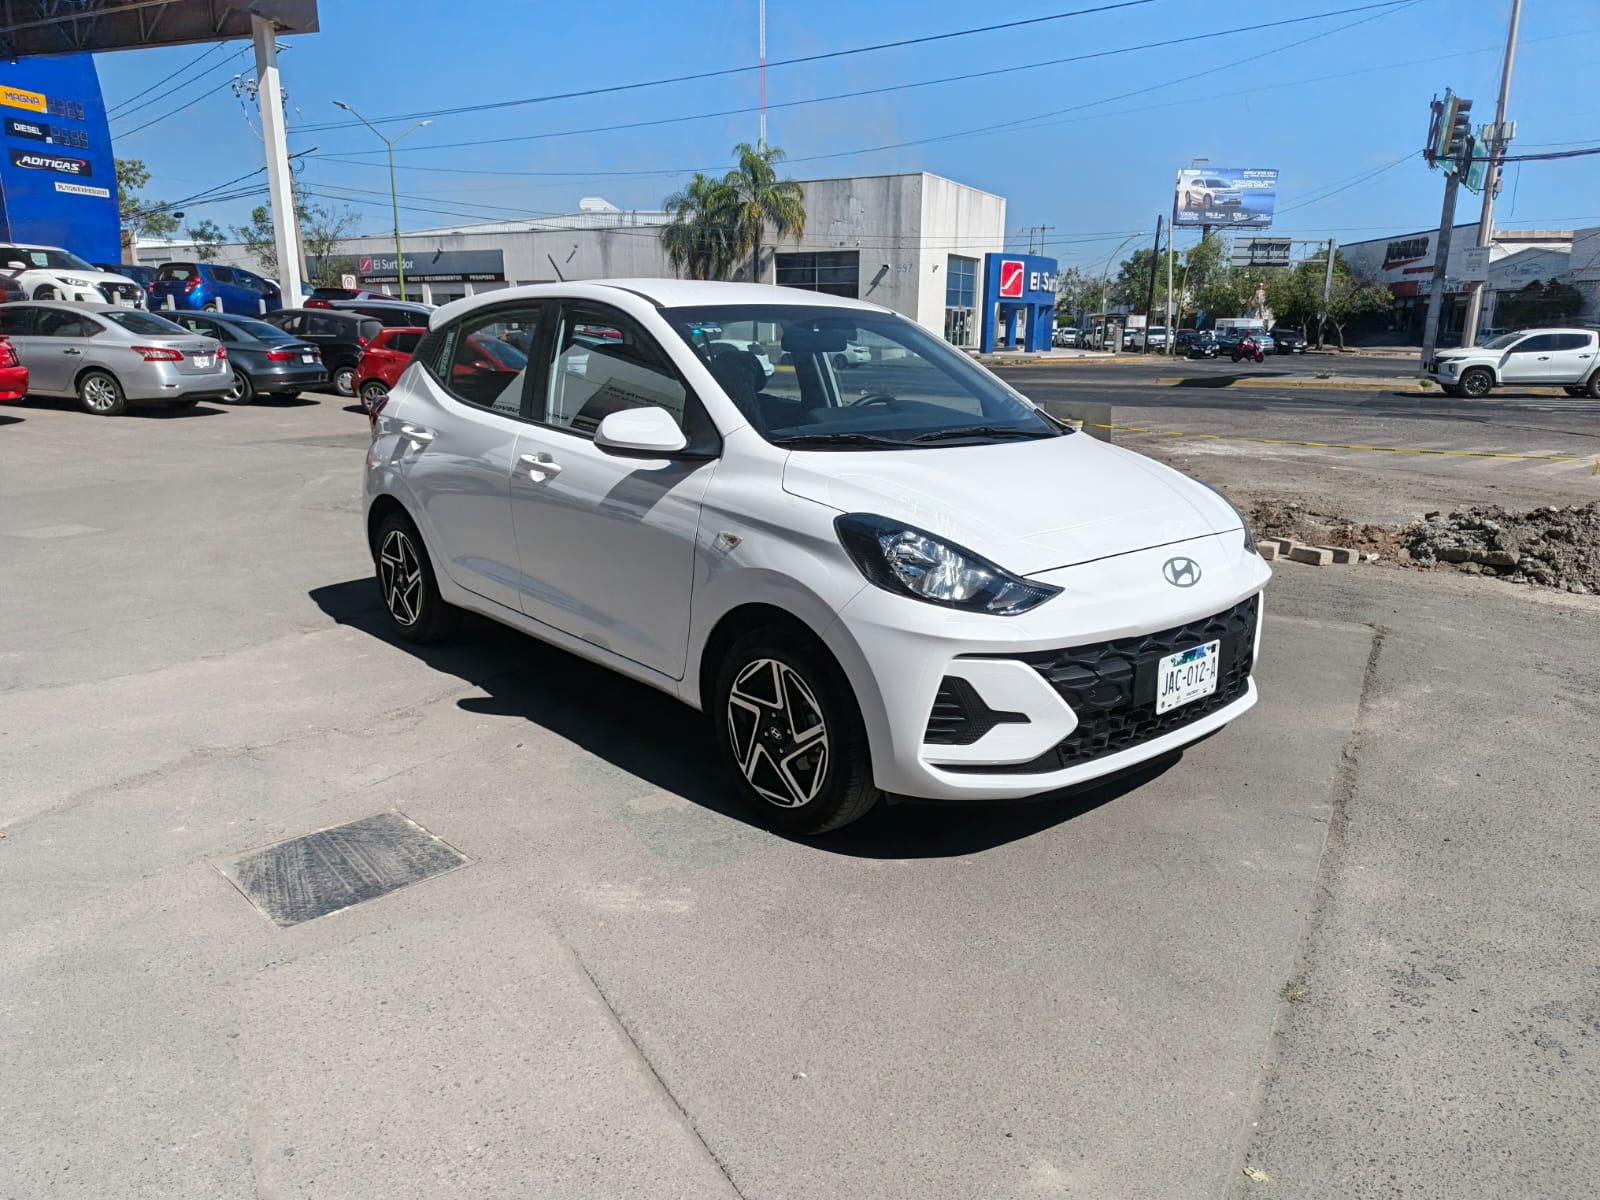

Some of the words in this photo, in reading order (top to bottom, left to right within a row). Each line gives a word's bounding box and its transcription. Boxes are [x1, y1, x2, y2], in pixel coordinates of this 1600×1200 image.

[4, 91, 41, 105] MAGNA
[13, 122, 42, 135] DIESEL
[22, 155, 80, 171] ADITIGAS
[373, 259, 380, 270] El
[381, 258, 414, 271] Surtdor
[1029, 271, 1041, 291] El
[1162, 656, 1216, 696] JAC-012-A
